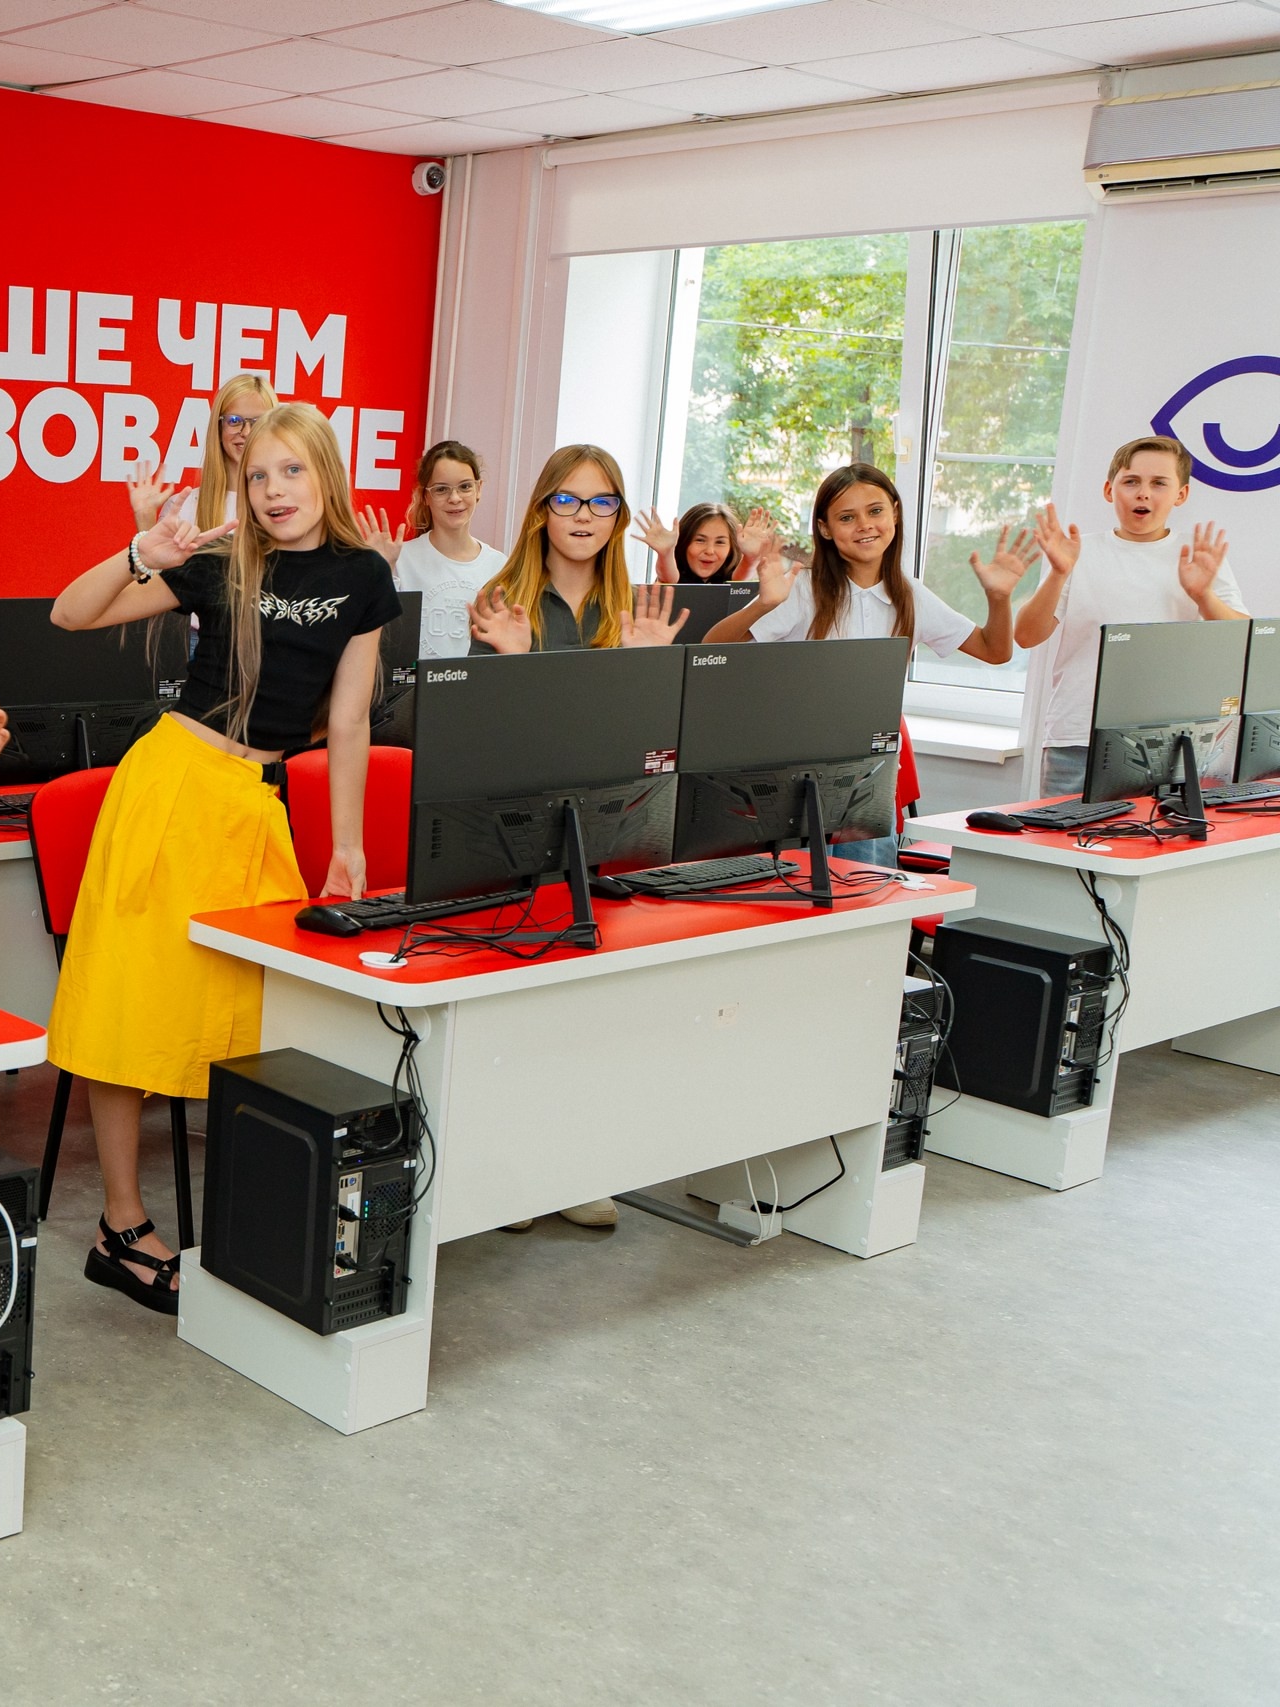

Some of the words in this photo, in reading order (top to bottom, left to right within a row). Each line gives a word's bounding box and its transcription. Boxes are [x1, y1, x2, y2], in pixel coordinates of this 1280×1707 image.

[157, 298, 348, 399] ЧЕМ
[692, 654, 728, 667] ExeGate
[426, 669, 468, 683] ExeGate
